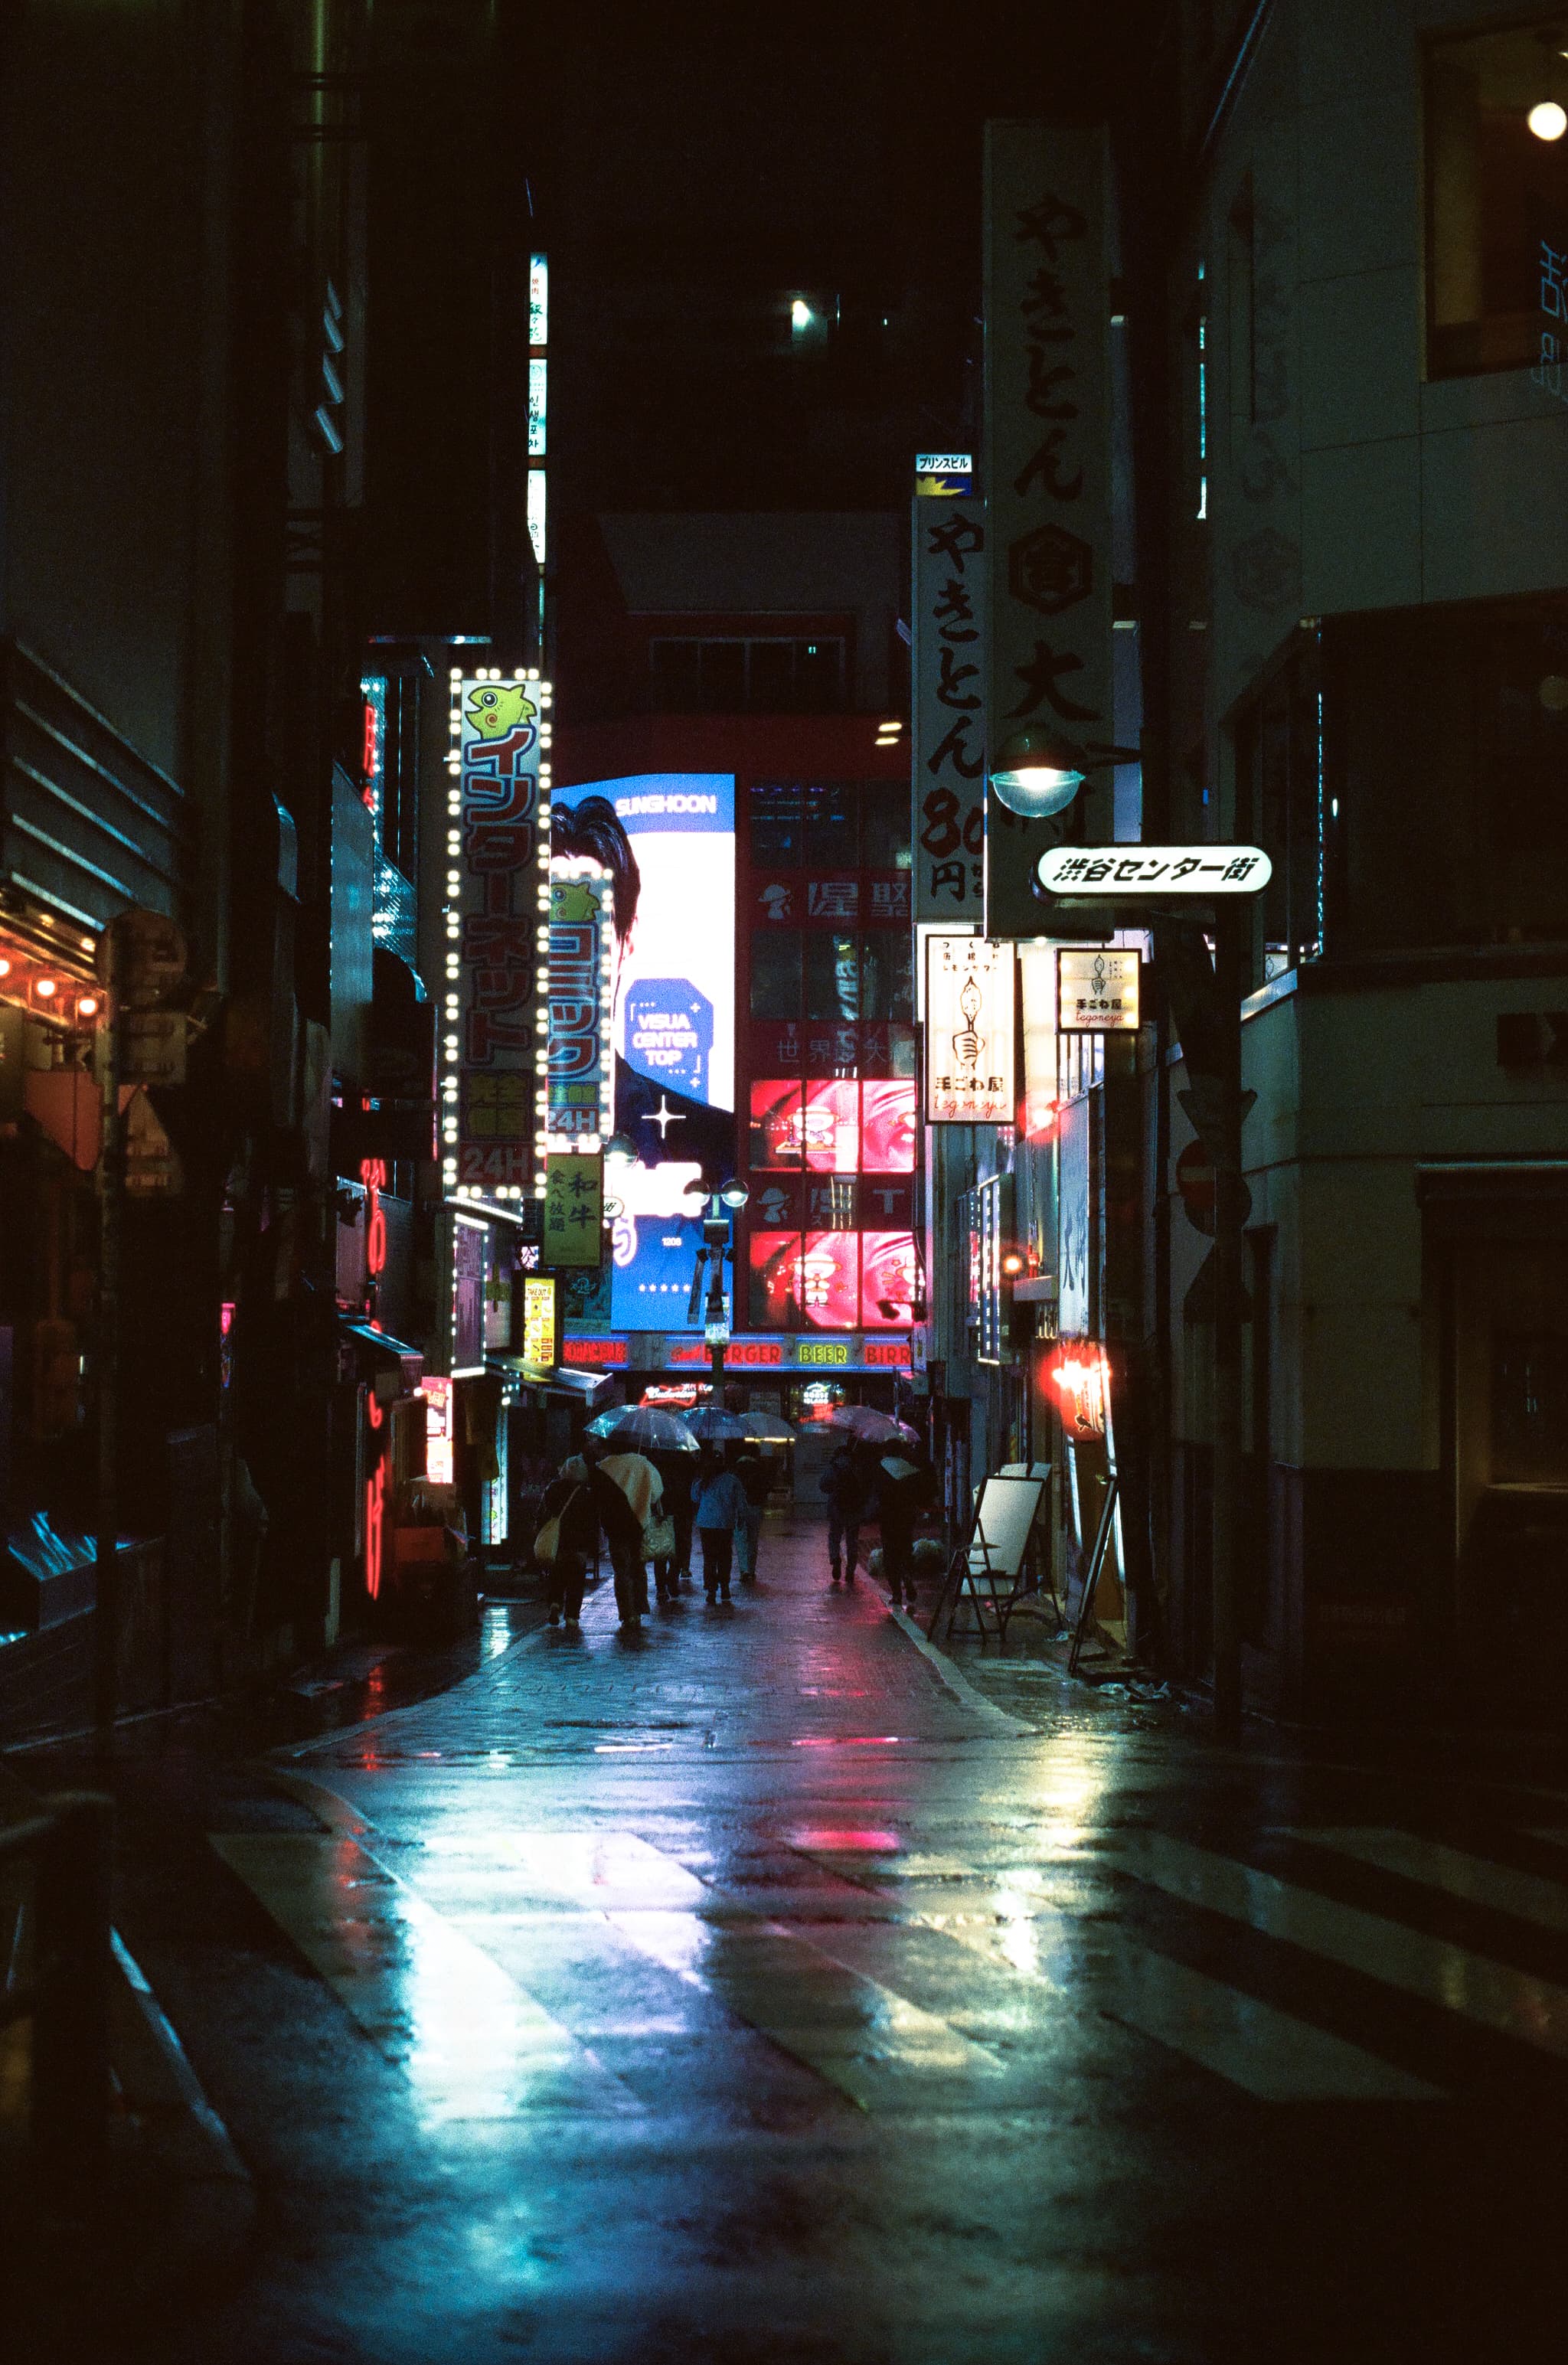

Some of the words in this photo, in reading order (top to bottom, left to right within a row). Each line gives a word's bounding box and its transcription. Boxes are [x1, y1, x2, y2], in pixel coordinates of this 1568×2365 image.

[1014, 193, 1087, 501] やきとん
[919, 456, 969, 469] プリンスビル
[616, 795, 717, 816] SUNGHOON
[1053, 857, 1260, 882] 渋谷センター街
[464, 724, 534, 1066] インターネット
[1076, 998, 1122, 1010] 手ごね屋
[1076, 1010, 1124, 1027] tegoneya
[645, 1050, 682, 1066] TOP
[936, 1076, 1004, 1093] 手ごね屋
[463, 1146, 529, 1181] 24H
[569, 1171, 598, 1230] 和牛
[704, 1344, 782, 1364] BRGER
[800, 1344, 847, 1364] BEER
[865, 1344, 911, 1364] BIRR
